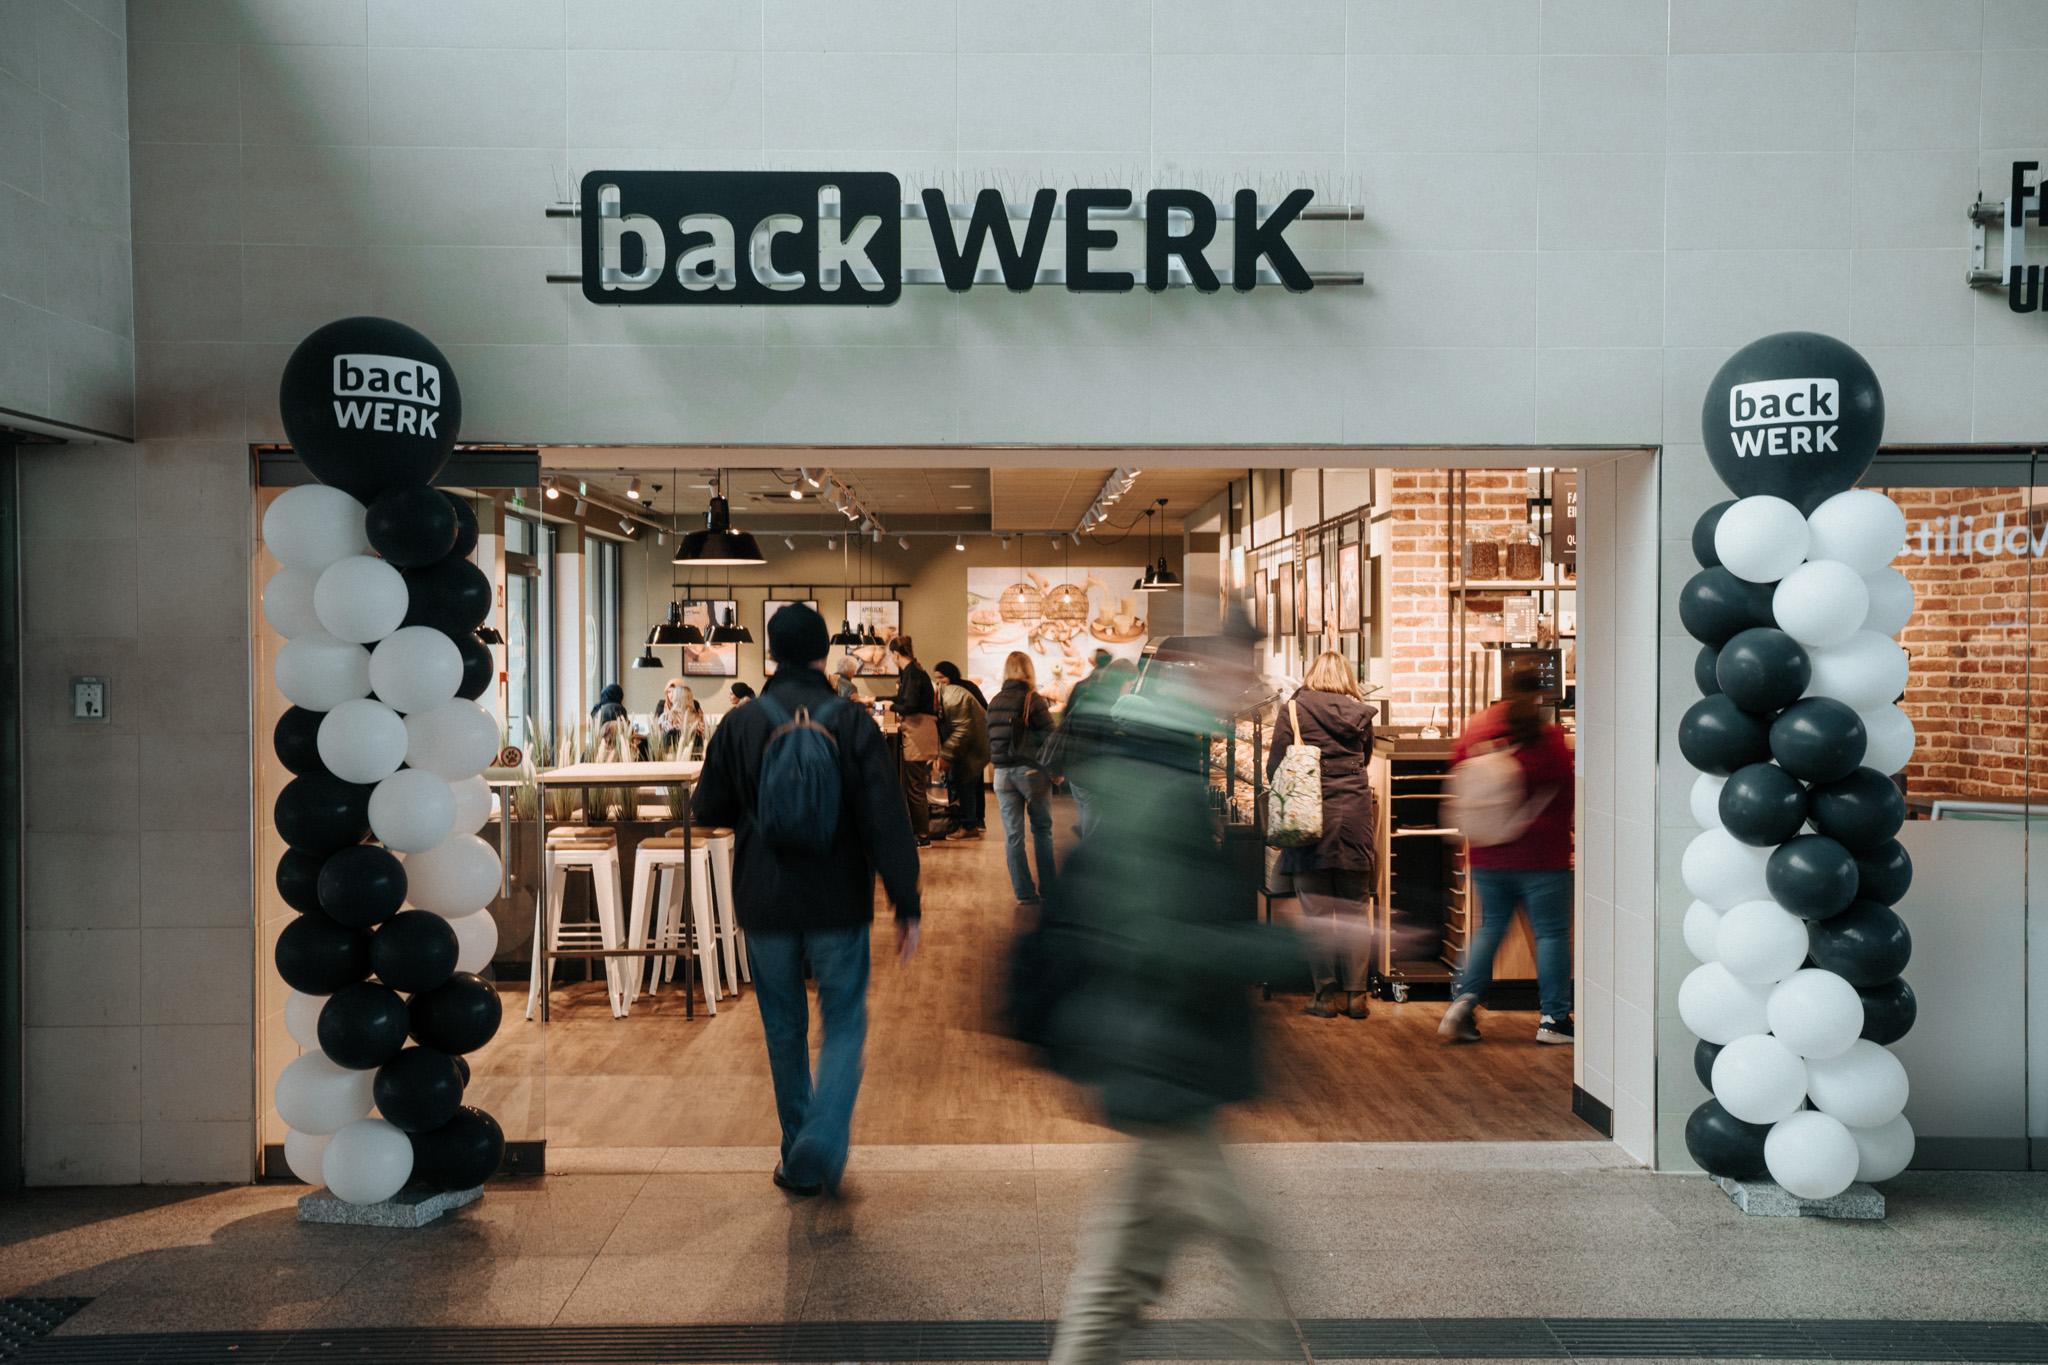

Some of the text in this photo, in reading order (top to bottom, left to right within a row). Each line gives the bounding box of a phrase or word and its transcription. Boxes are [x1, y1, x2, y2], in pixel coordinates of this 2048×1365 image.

[598, 183, 1316, 293] back WERK
[340, 358, 436, 401] back
[333, 401, 440, 439] WERK
[1735, 383, 1833, 422] back
[1730, 425, 1839, 458] WERK
[1567, 505, 1577, 518] EI
